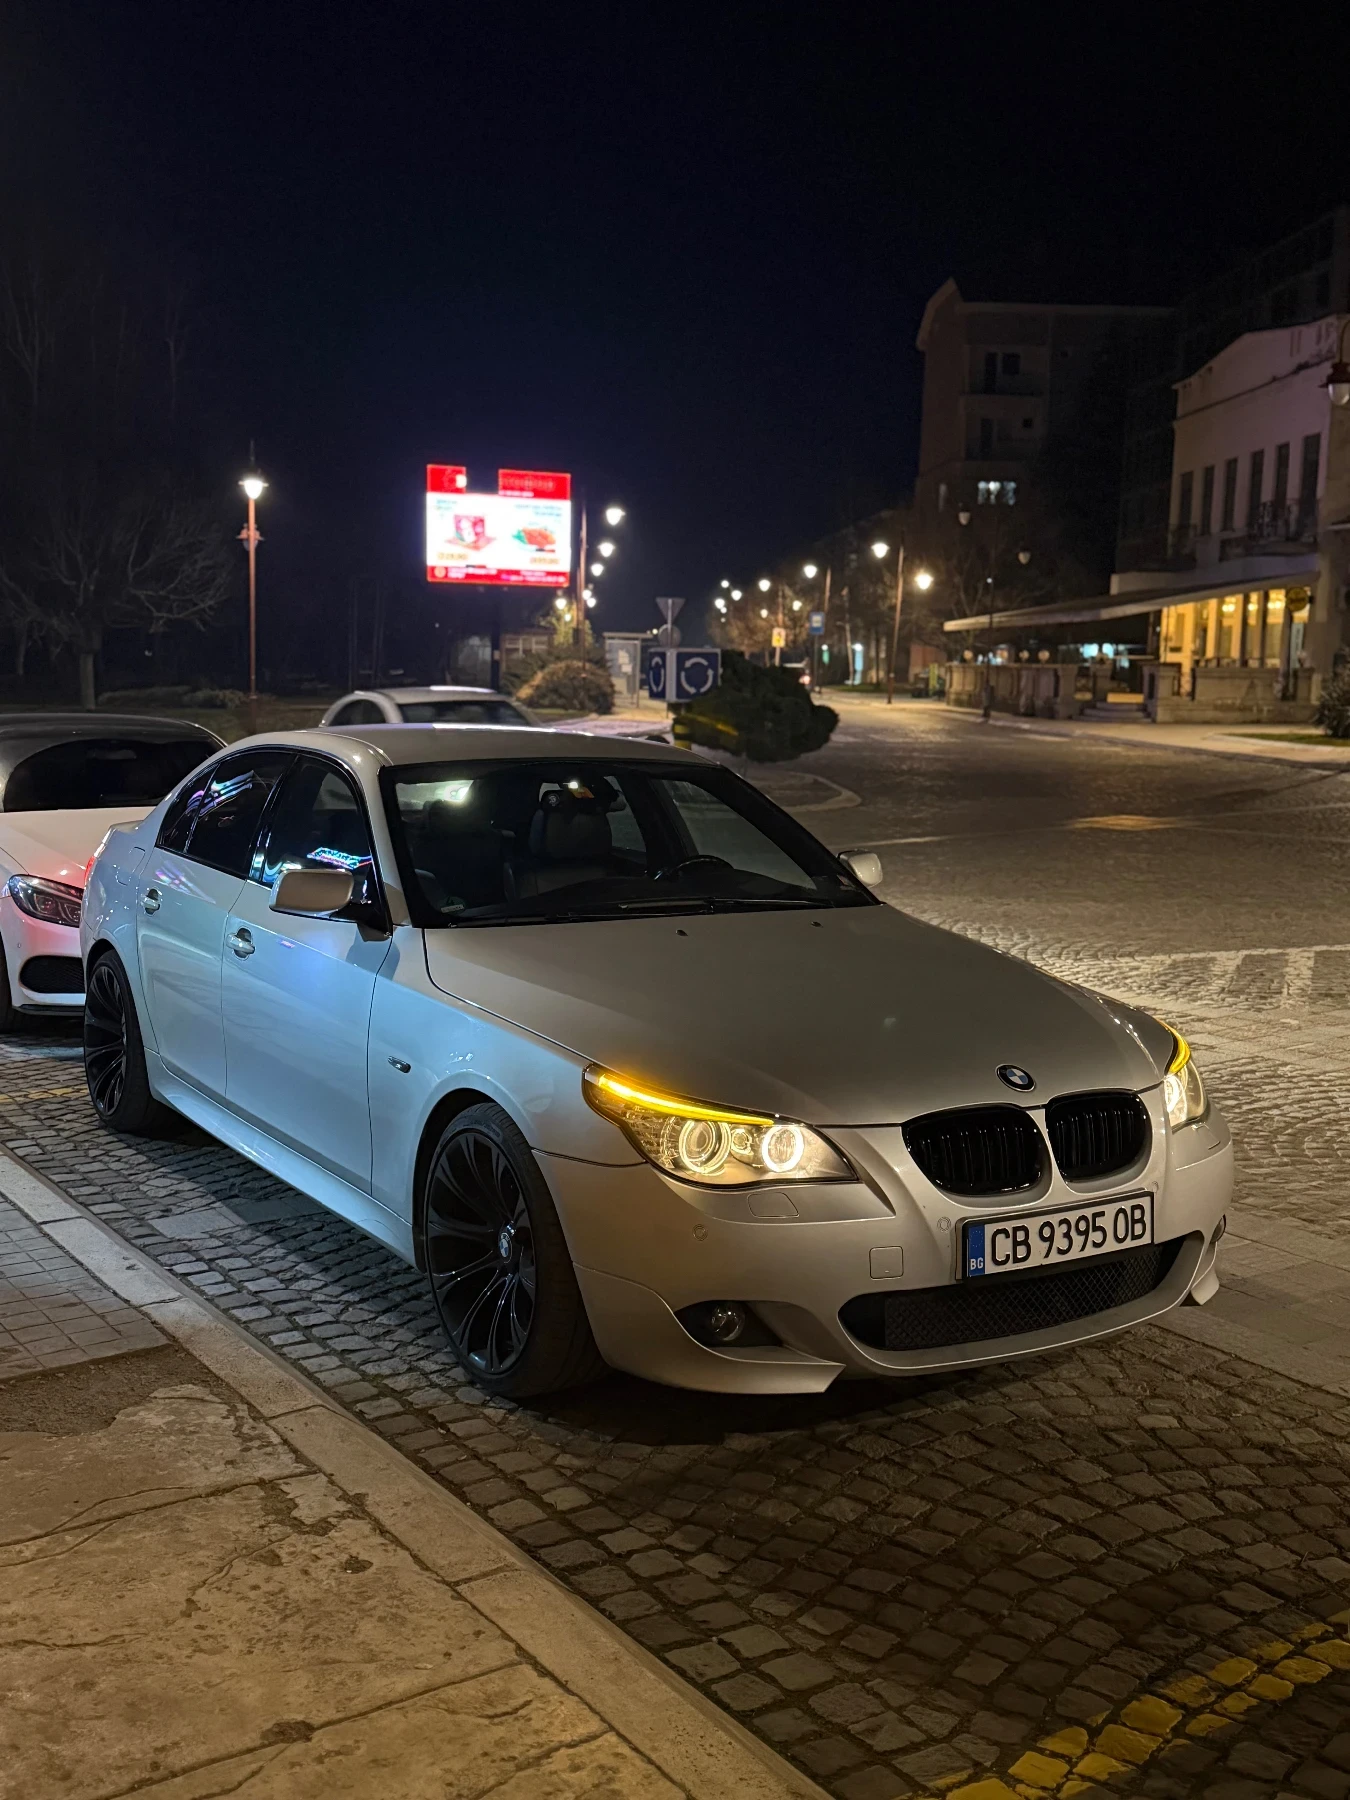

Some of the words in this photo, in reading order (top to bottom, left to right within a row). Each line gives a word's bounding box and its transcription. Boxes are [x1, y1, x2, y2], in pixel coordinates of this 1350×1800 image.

[991, 1224, 1032, 1266] CB
[1038, 1210, 1107, 1259] 9395
[970, 1257, 984, 1270] BG
